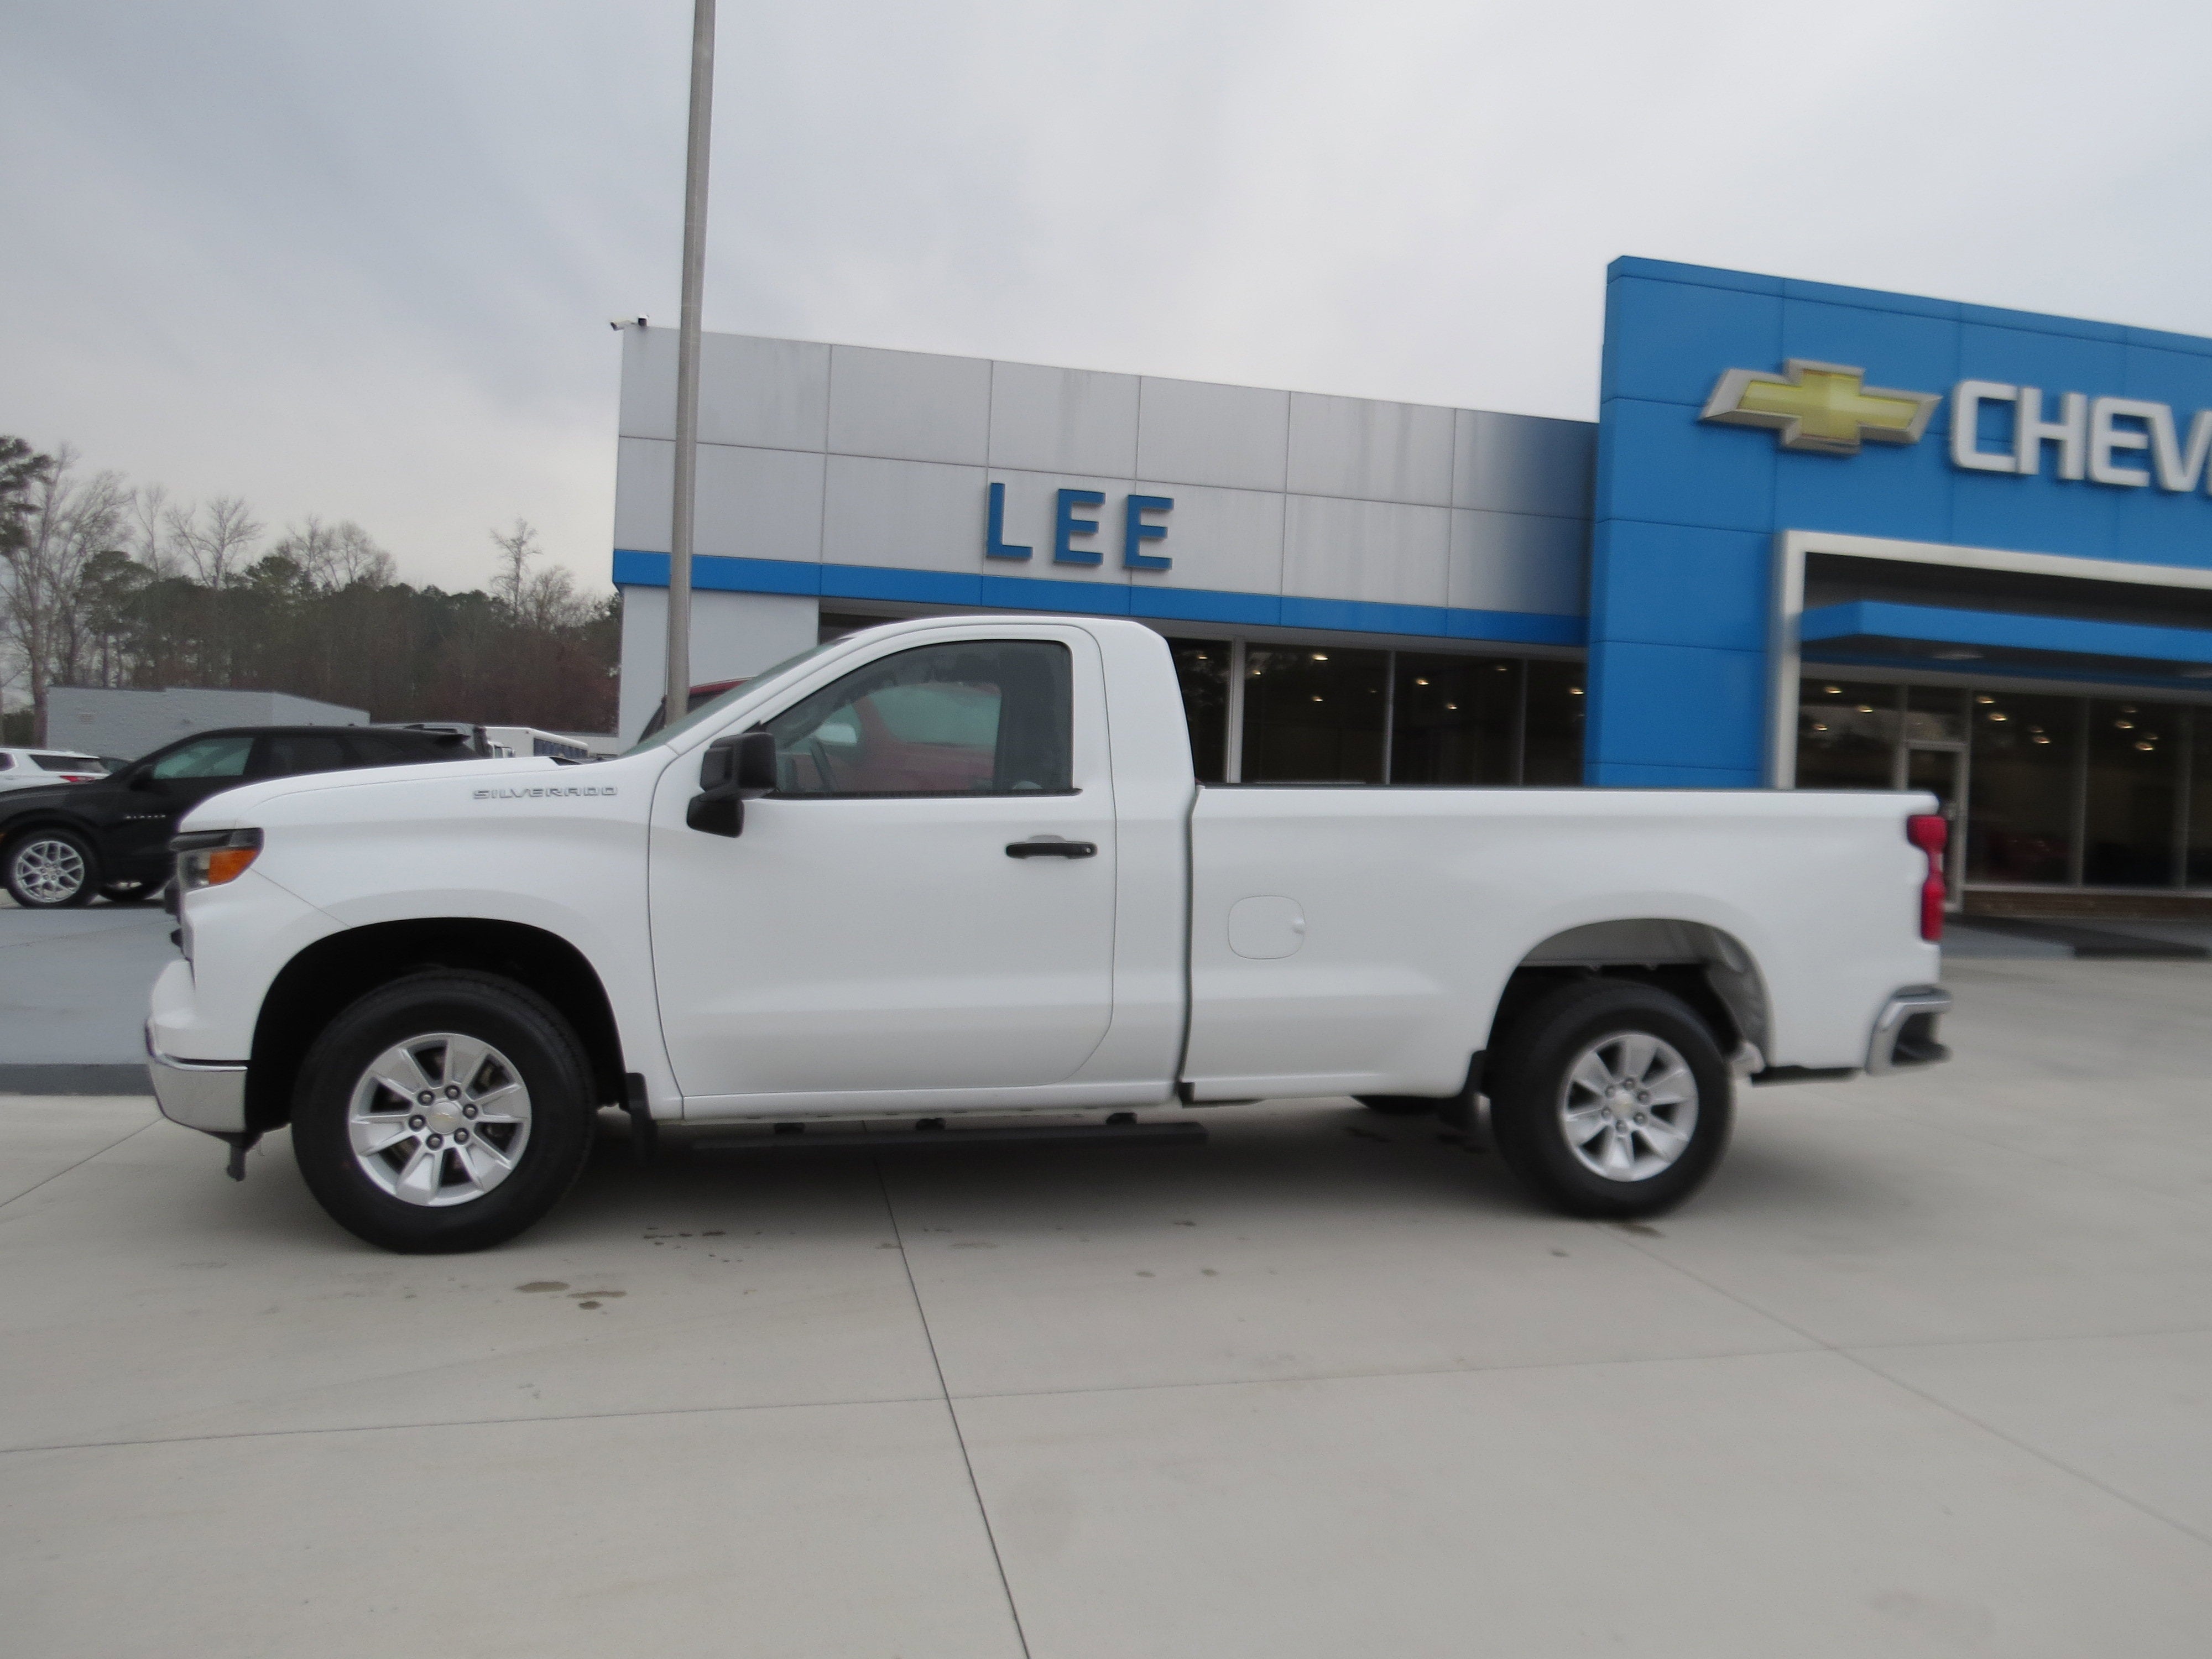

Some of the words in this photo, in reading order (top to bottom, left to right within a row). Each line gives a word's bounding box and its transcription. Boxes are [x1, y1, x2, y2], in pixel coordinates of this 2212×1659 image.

[1950, 379, 2212, 495] CHEV
[987, 482, 1175, 570] LEE
[473, 786, 618, 800] SILVERADO
